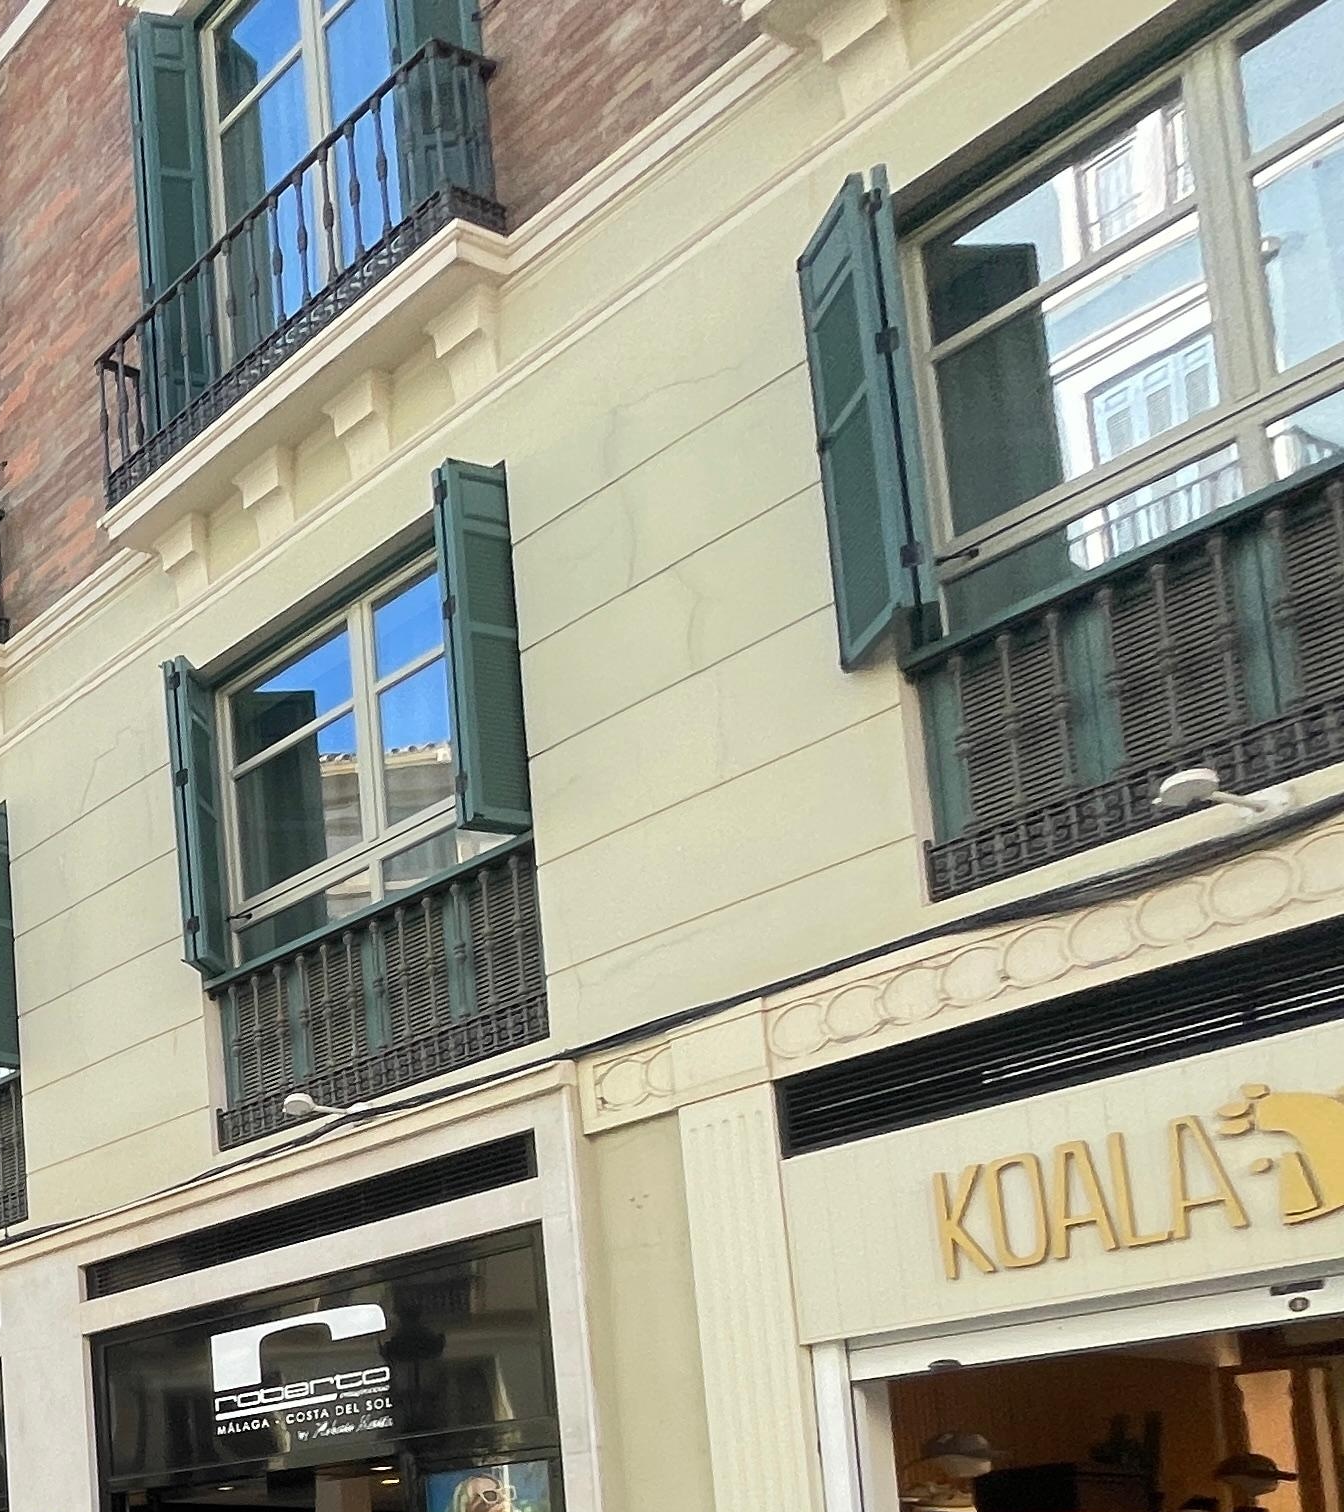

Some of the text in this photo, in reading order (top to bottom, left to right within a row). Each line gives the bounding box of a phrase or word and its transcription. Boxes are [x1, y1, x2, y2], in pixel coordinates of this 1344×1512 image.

[932, 1114, 1250, 1280] KOALA
[214, 1366, 391, 1412] roberto
[216, 1397, 393, 1436] MÁLAGA COSTA DEL SOL
